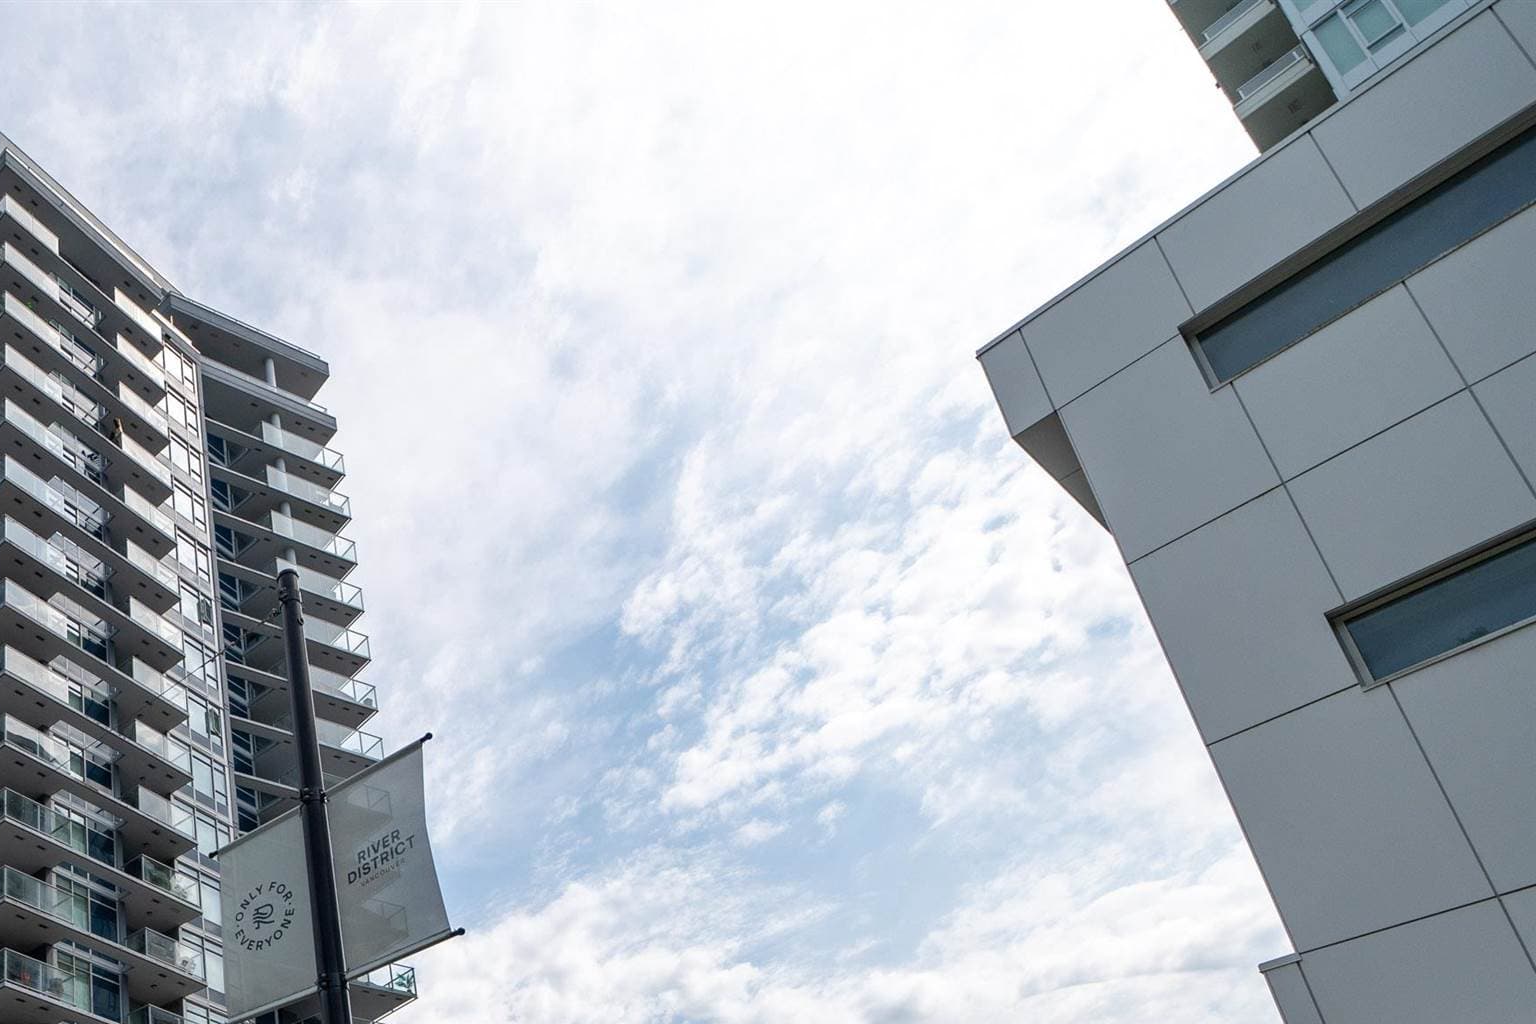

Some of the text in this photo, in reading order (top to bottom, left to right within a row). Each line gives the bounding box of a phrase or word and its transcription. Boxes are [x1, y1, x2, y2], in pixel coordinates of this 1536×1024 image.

[347, 834, 415, 885] DISTRICT
[357, 829, 401, 864] RIVER
[235, 882, 293, 922] ONLY FOR
[234, 908, 295, 951] EVERYONE
